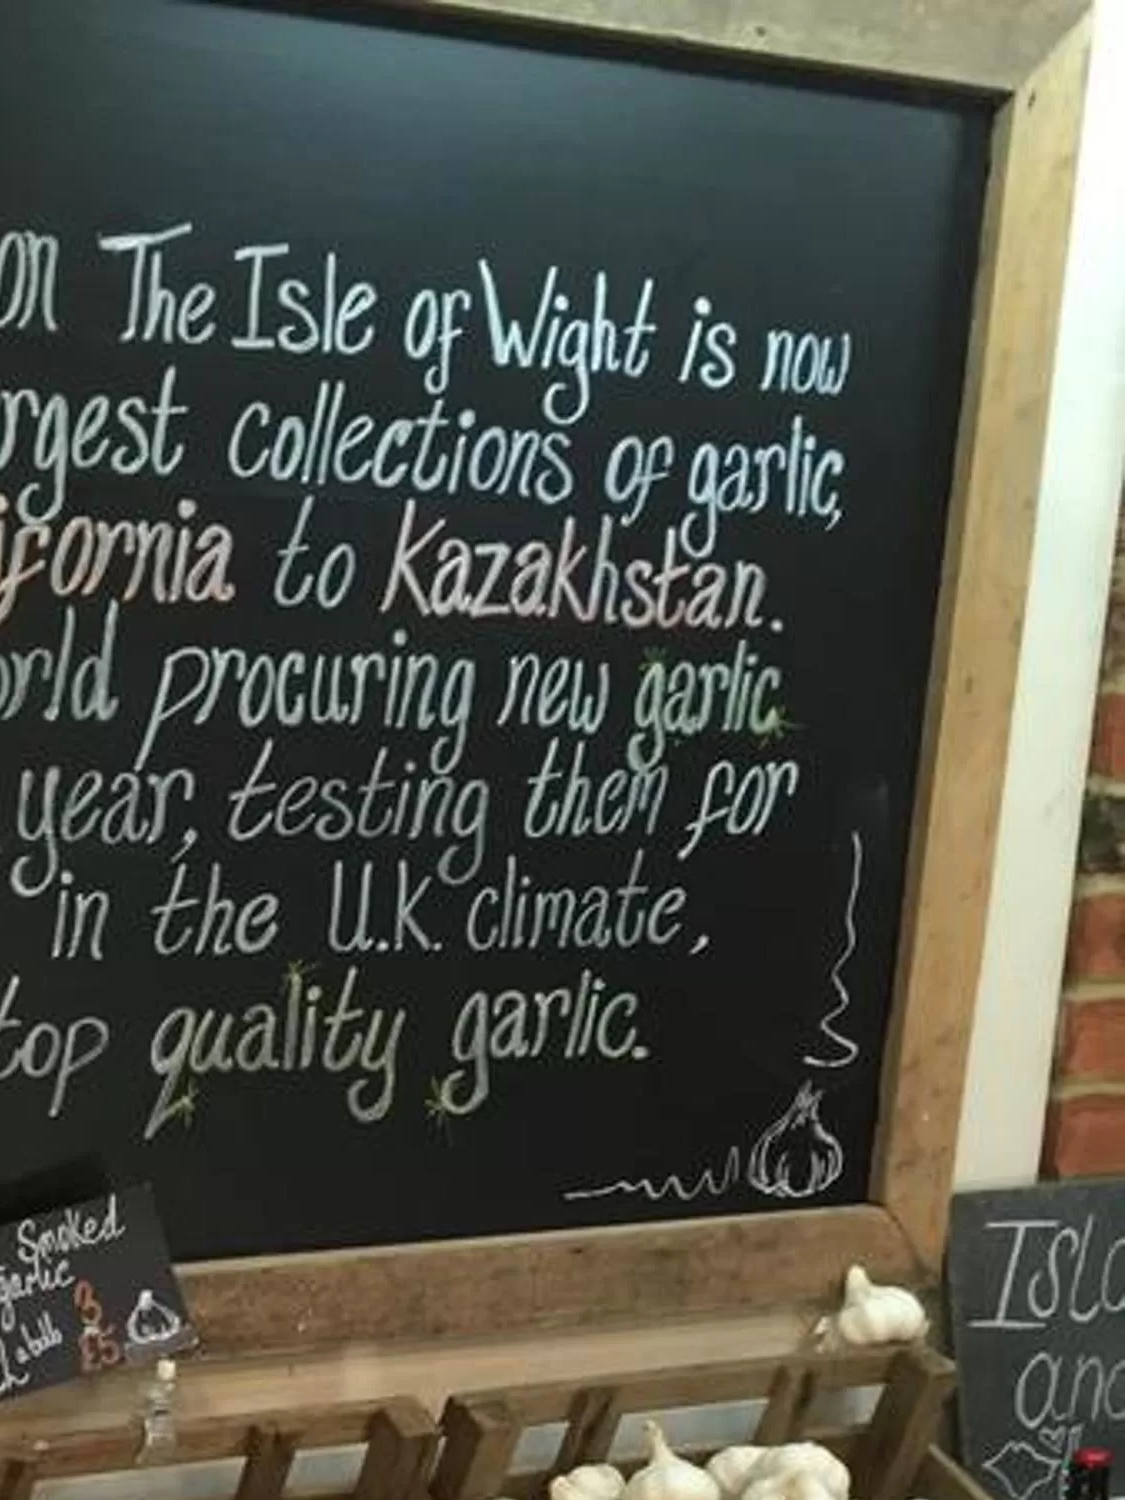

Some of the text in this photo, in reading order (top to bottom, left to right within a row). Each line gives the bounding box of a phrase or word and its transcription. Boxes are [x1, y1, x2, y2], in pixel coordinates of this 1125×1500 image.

[98, 223, 216, 344] The
[231, 244, 377, 355] Isle
[404, 281, 471, 394] of
[478, 258, 658, 425] Wight
[677, 295, 738, 394] is
[761, 327, 851, 396] now
[228, 381, 575, 504] collections
[603, 434, 677, 529] of
[275, 494, 356, 611] to
[380, 499, 786, 633] Kazakhstan.
[136, 629, 474, 771] procuring
[498, 652, 611, 737] new
[627, 640, 782, 771] garlic
[228, 739, 488, 885] testing
[524, 736, 668, 839] them
[677, 758, 800, 861] for
[50, 870, 110, 961] in
[151, 861, 279, 958] the
[143, 965, 406, 1139] quality
[440, 969, 650, 1116] garlic.
[18, 1192, 126, 1264] Smoked
